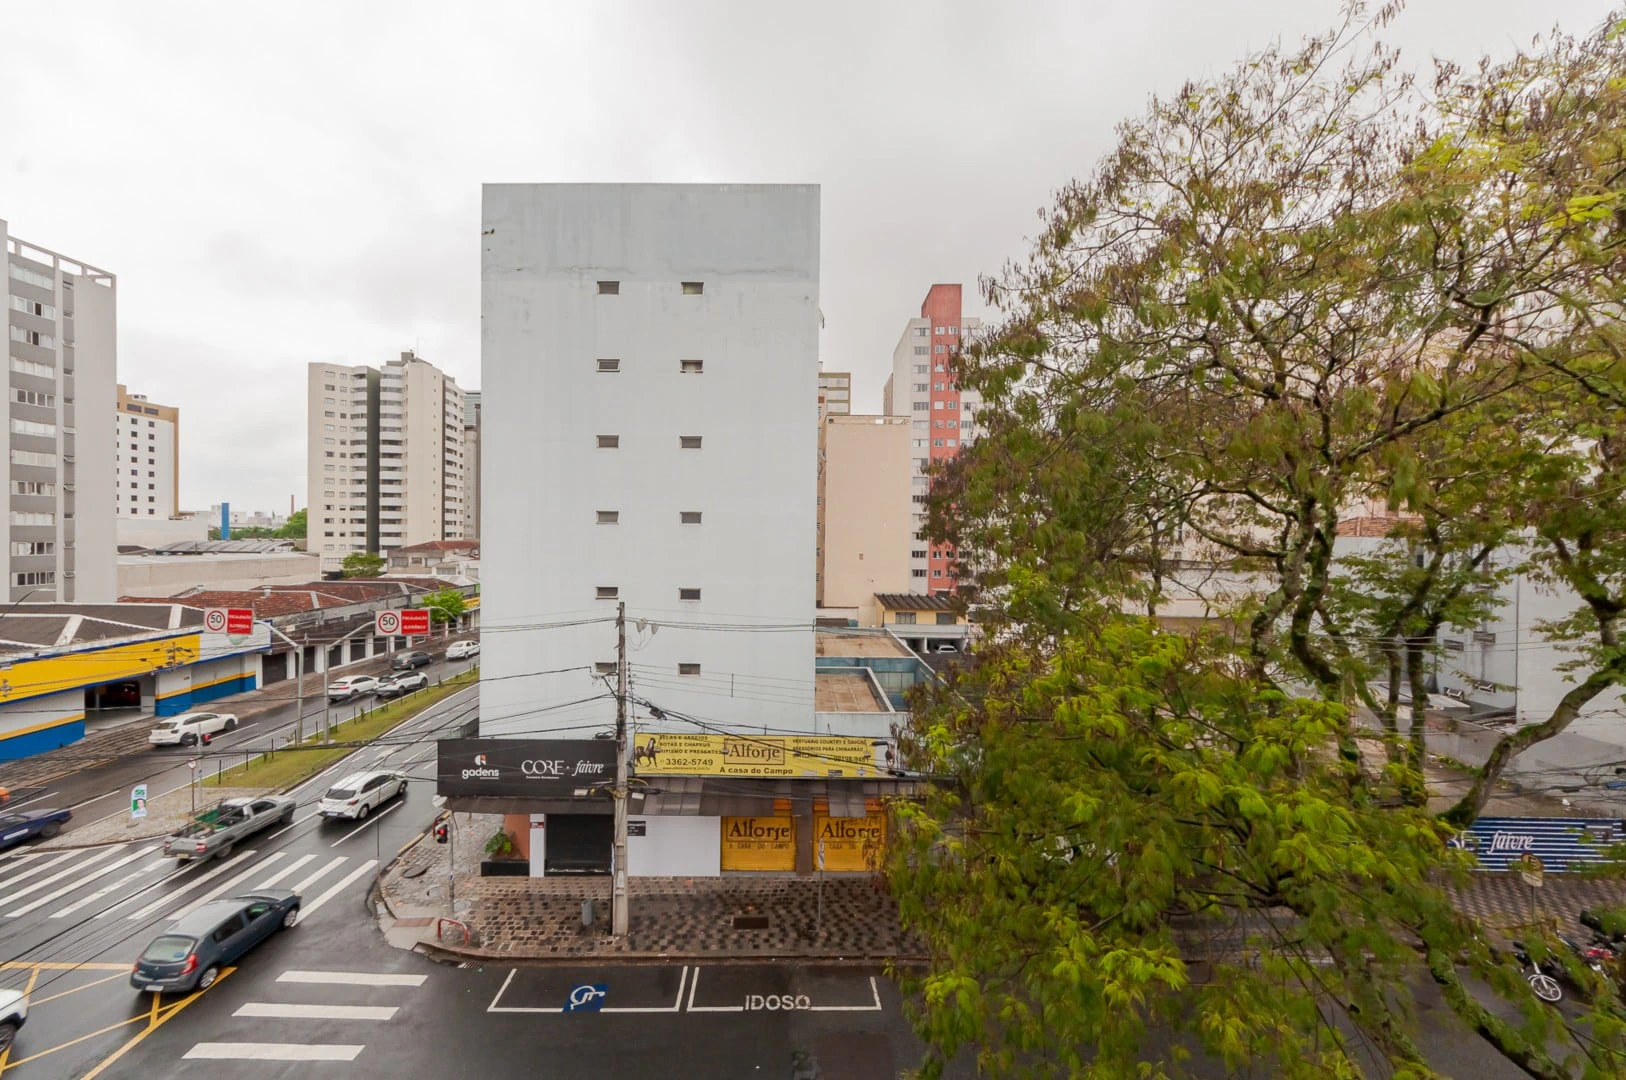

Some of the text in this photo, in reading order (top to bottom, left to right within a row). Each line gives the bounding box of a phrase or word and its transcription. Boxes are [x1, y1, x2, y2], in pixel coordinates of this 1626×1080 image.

[210, 614, 222, 624] 50
[382, 616, 396, 626] 50
[729, 743, 780, 761] Alforje
[521, 759, 565, 776] CORE
[666, 758, 713, 766] 3362-5749
[462, 767, 500, 780] gadens
[764, 767, 793, 776] Campo
[729, 818, 790, 841] Alforje
[744, 994, 812, 1011] IDOSO
